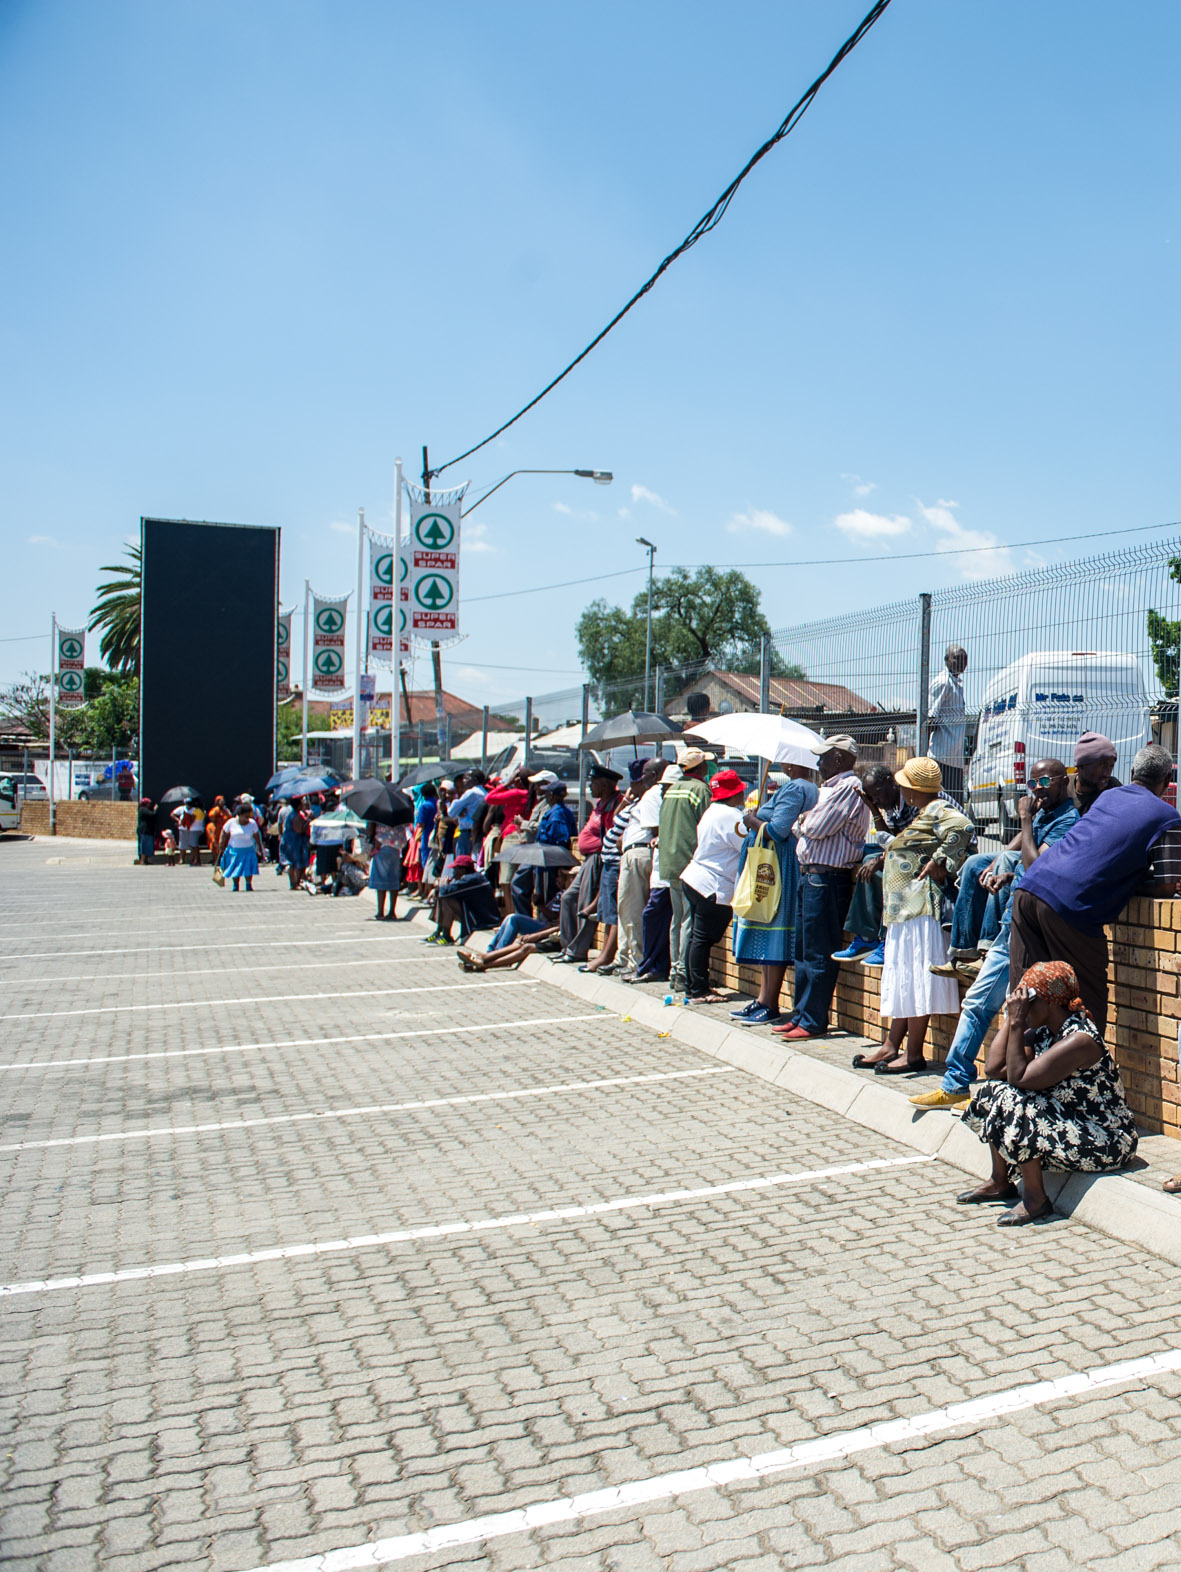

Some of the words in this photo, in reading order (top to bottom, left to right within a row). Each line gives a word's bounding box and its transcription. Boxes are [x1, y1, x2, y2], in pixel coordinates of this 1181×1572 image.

[414, 551, 456, 560] SUPER
[418, 560, 451, 568] SPAR
[414, 612, 456, 620] SUPER
